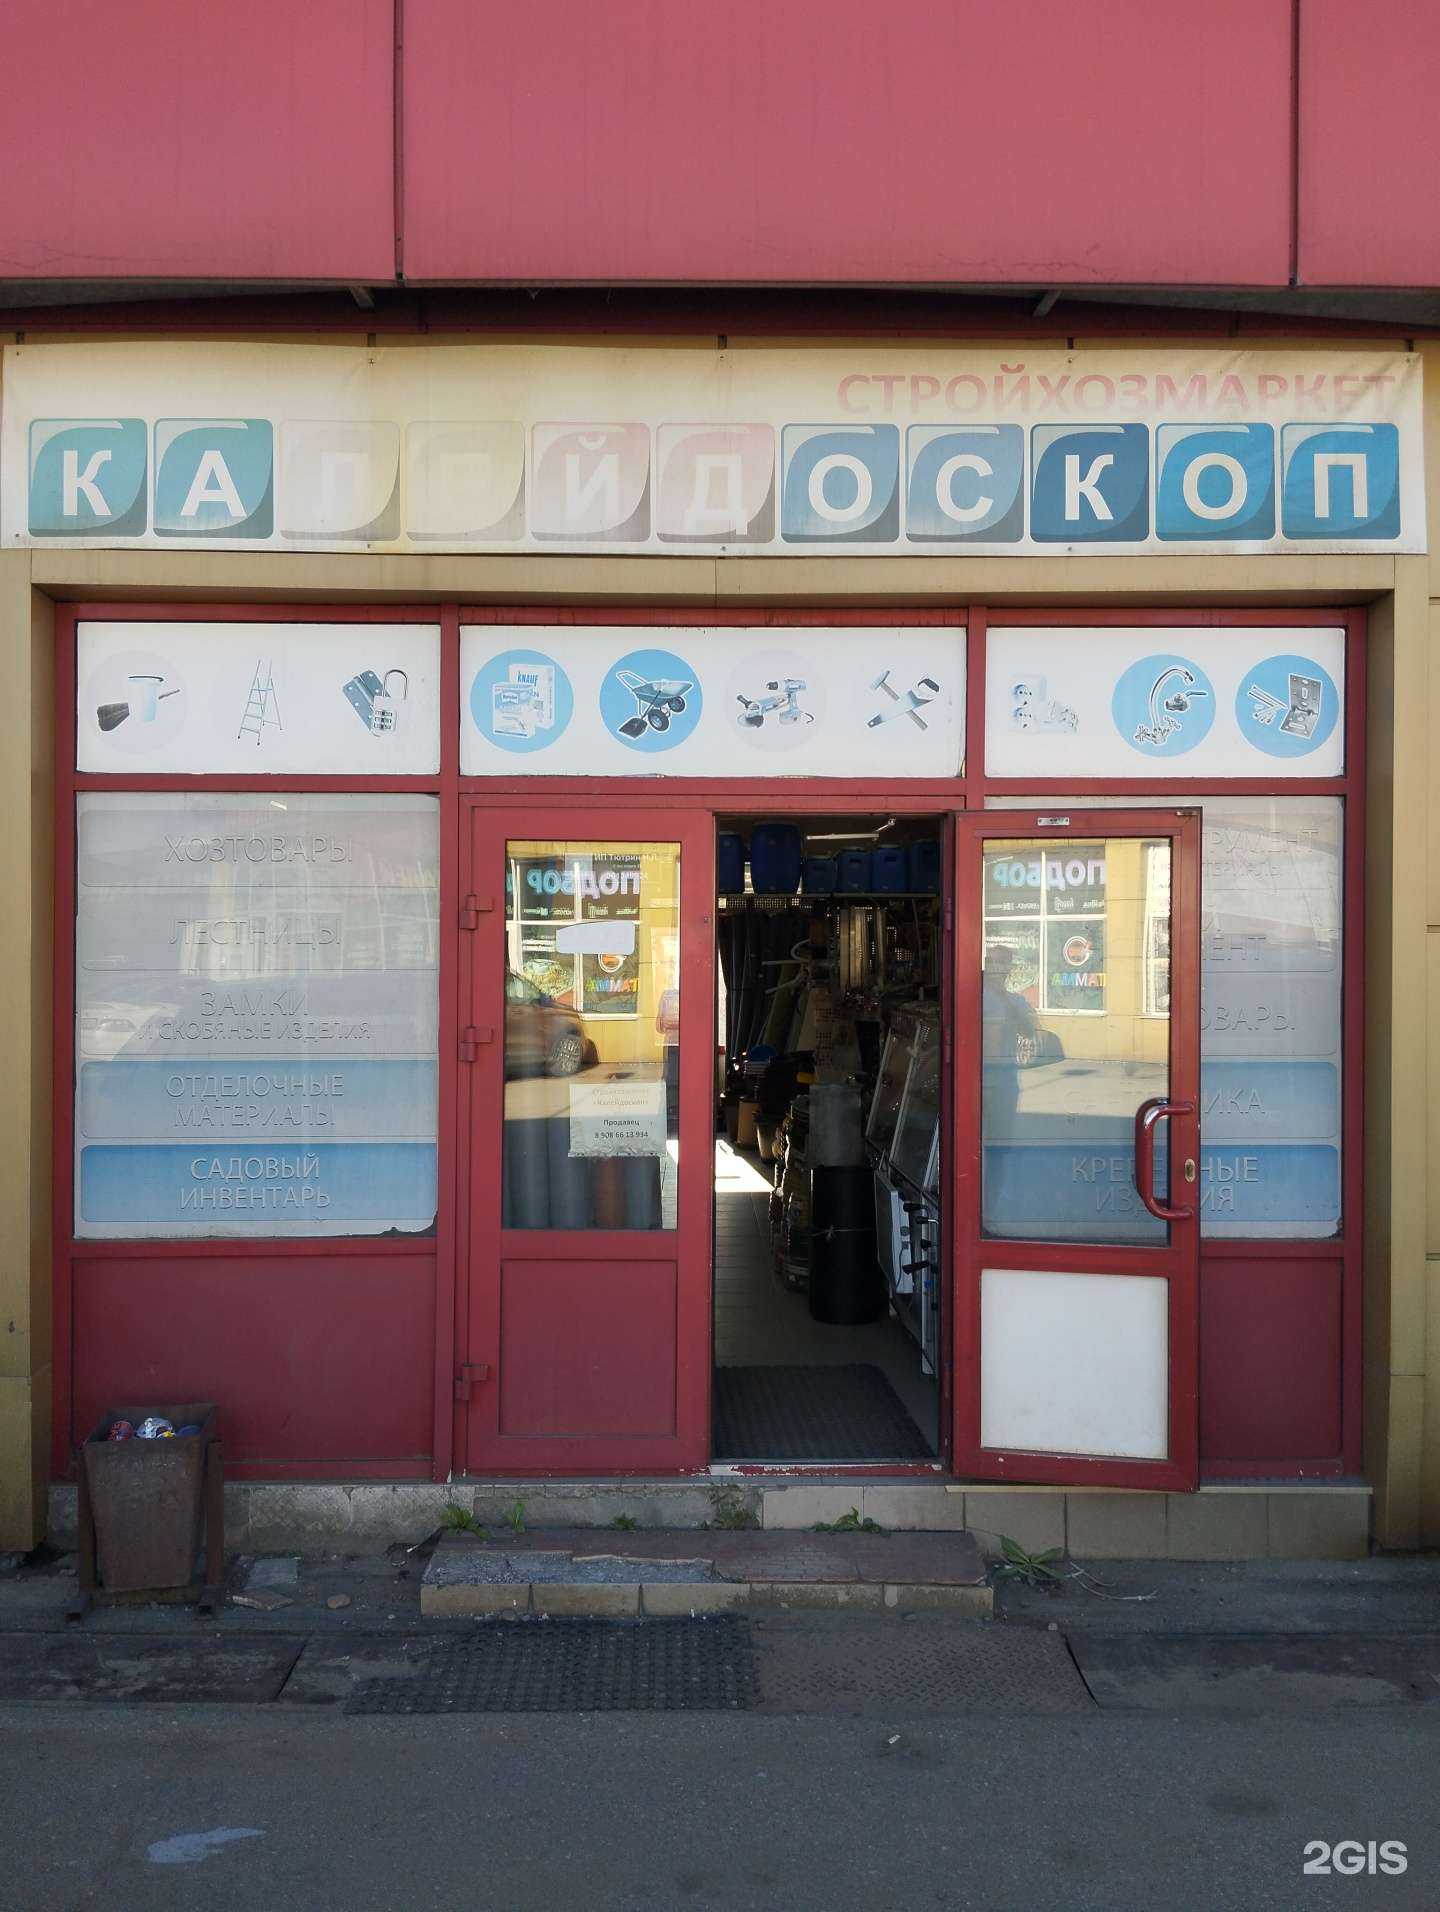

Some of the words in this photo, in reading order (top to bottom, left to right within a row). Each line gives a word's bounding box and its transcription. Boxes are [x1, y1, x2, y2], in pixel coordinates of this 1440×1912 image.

[836, 364, 1396, 414] СТРОЙХОЗМАРКЕТ
[163, 835, 353, 863] ХОЗТОВАРЫ
[168, 918, 342, 950] ЛЕСТНИЦЫ
[199, 991, 311, 1016] ЗАМКИ
[158, 1021, 274, 1041] СКОБЯНЫЕ
[278, 1021, 372, 1043] ИЗДЕЛИЯ
[166, 1074, 344, 1102] ОТДЕЛОЧНЫЕ
[174, 1104, 336, 1128] МАТЕРИАЛЫ
[603, 1119, 640, 1127] Продавец
[190, 1153, 320, 1183] САДОВЫЙ
[179, 1186, 331, 1210] ИНВЕНТАРЬ
